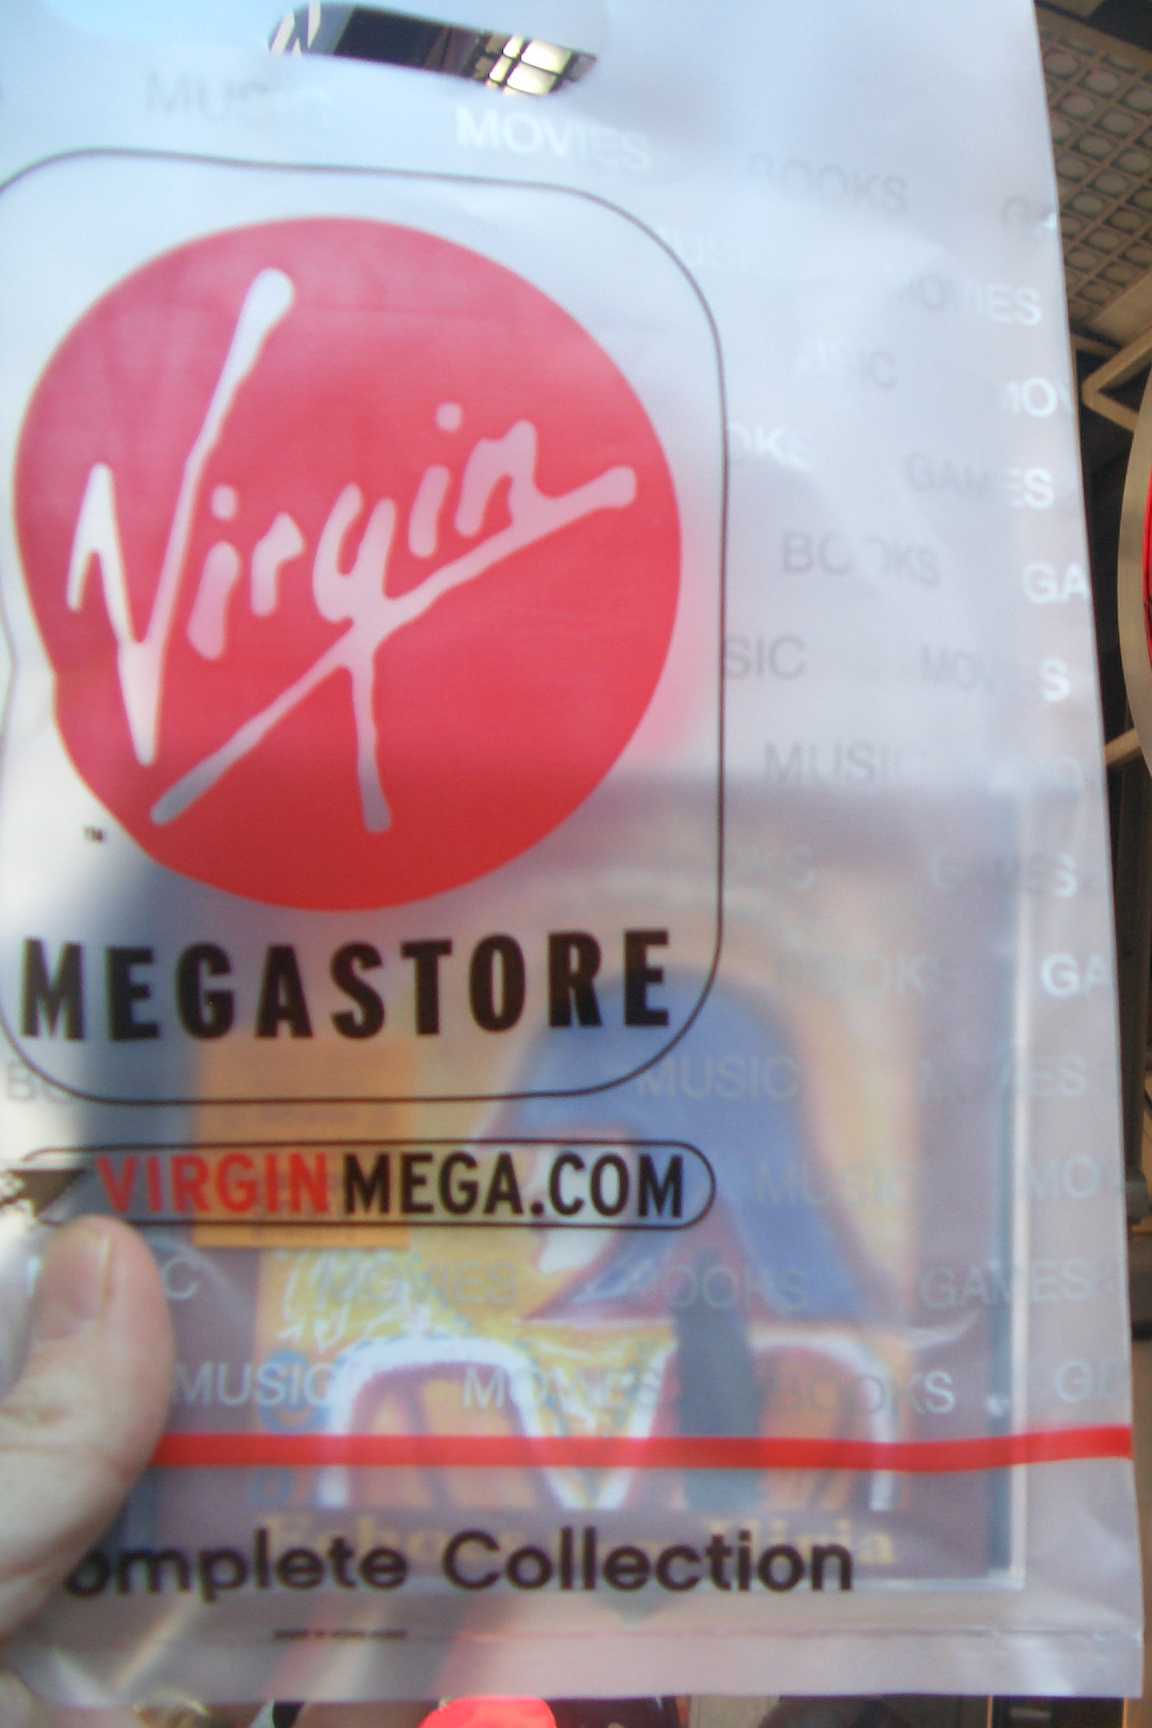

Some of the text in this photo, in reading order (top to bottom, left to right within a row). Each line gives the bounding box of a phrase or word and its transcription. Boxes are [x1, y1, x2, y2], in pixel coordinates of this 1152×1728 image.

[65, 267, 636, 833] Virgin
[20, 927, 670, 1041] MEGASTORE
[173, 1360, 340, 1407] MUSIC
[65, 1527, 408, 1602] omplete
[442, 1527, 855, 1592] Collection
